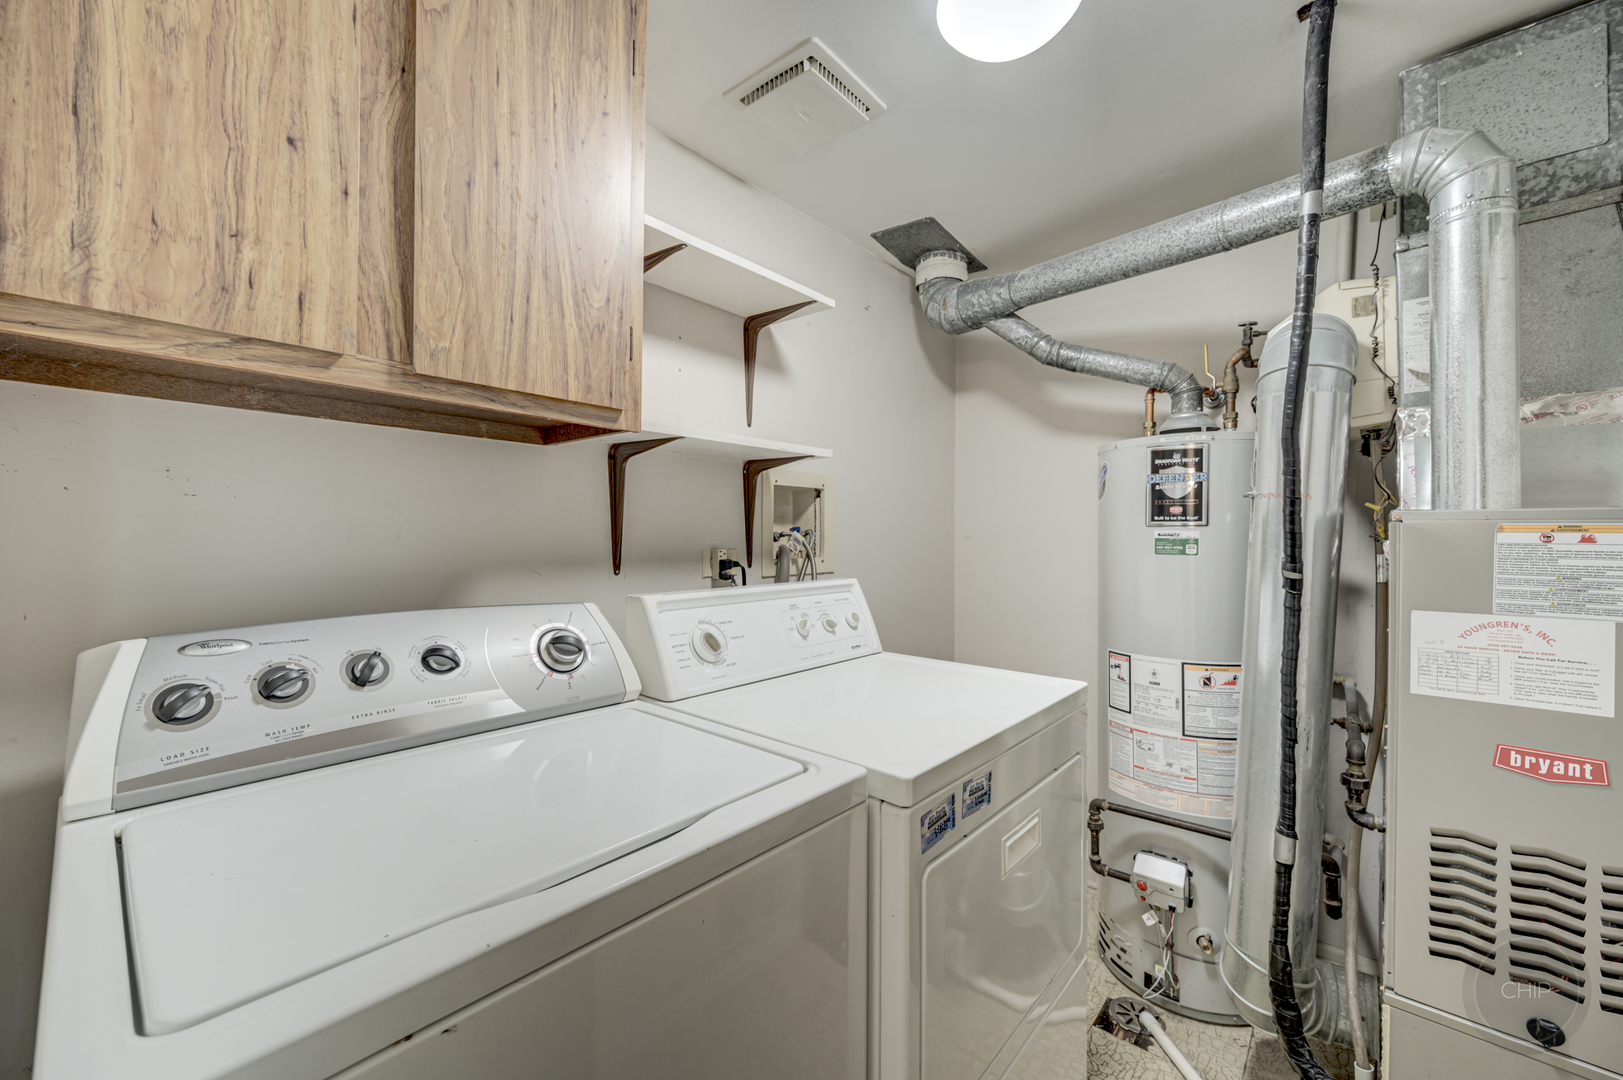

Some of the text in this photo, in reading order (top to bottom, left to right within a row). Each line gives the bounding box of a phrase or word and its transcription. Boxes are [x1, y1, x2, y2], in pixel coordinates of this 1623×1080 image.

[1148, 472, 1208, 483] DEFENDER
[1458, 621, 1556, 648] YOUNGREN'S, INC.
[197, 642, 233, 650] Whirlpool
[163, 674, 188, 682] Medium
[352, 711, 373, 720] EXTRA
[265, 729, 287, 738] WASH
[290, 724, 311, 733] TEMP
[160, 746, 210, 762] LOAD SIZE
[1510, 750, 1593, 780] bryant
